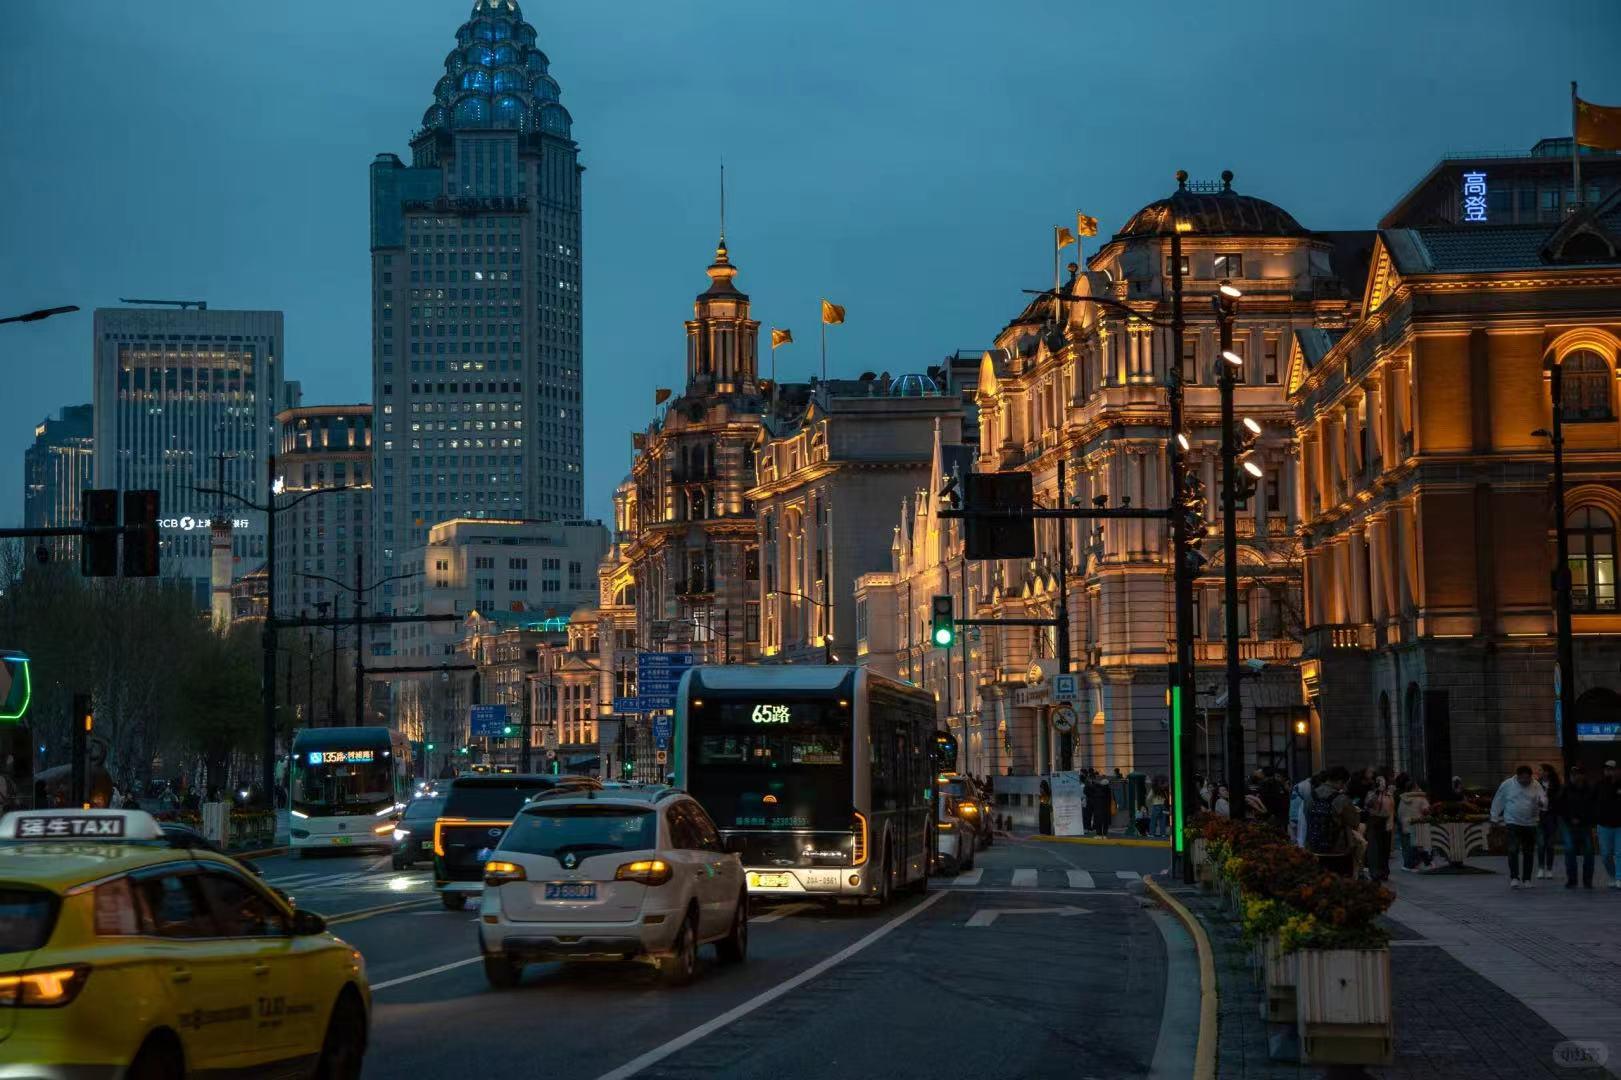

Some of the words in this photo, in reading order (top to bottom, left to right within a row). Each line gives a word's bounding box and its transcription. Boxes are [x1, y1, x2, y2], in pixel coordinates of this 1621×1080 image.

[1463, 171, 1487, 222] 高登
[196, 519, 249, 528] 上海银行
[752, 704, 791, 723] 65路
